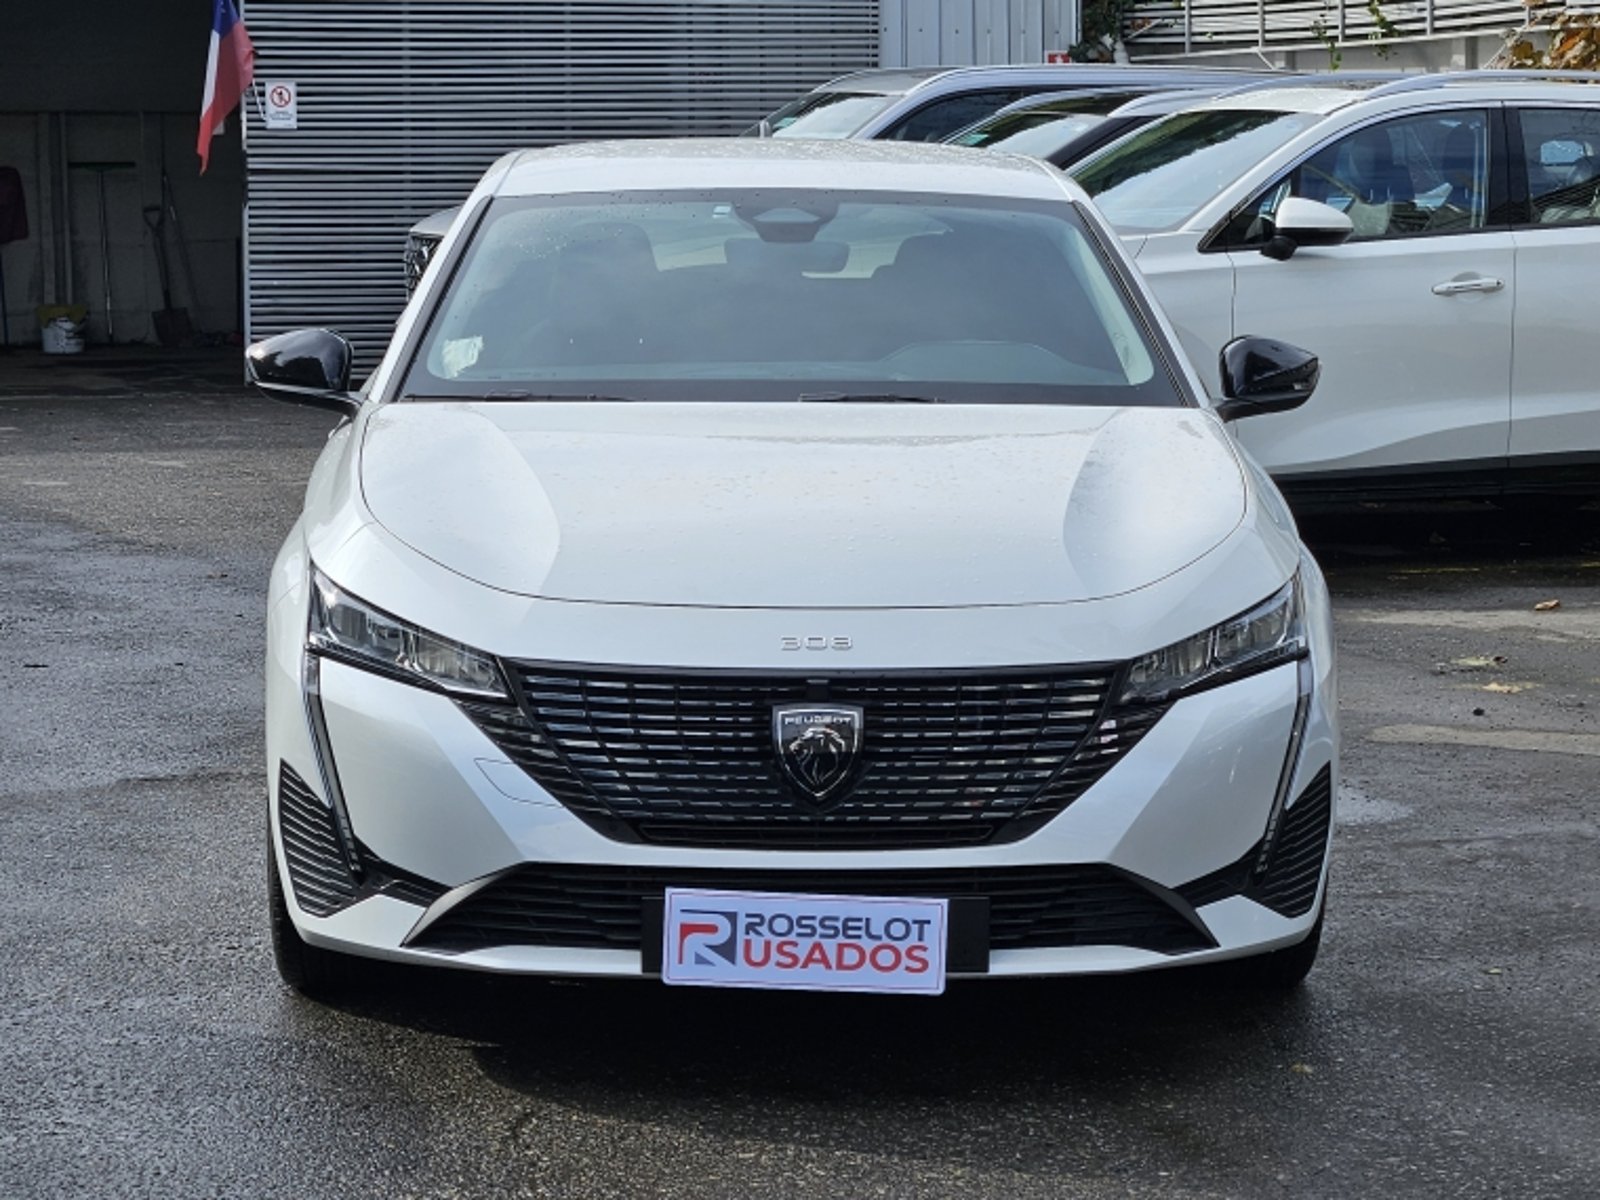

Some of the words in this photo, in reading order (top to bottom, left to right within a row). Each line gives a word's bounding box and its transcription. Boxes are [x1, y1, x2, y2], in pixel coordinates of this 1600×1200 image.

[781, 636, 852, 650] 308
[744, 912, 931, 942] ROSSELOT
[742, 938, 930, 973] USADOS
